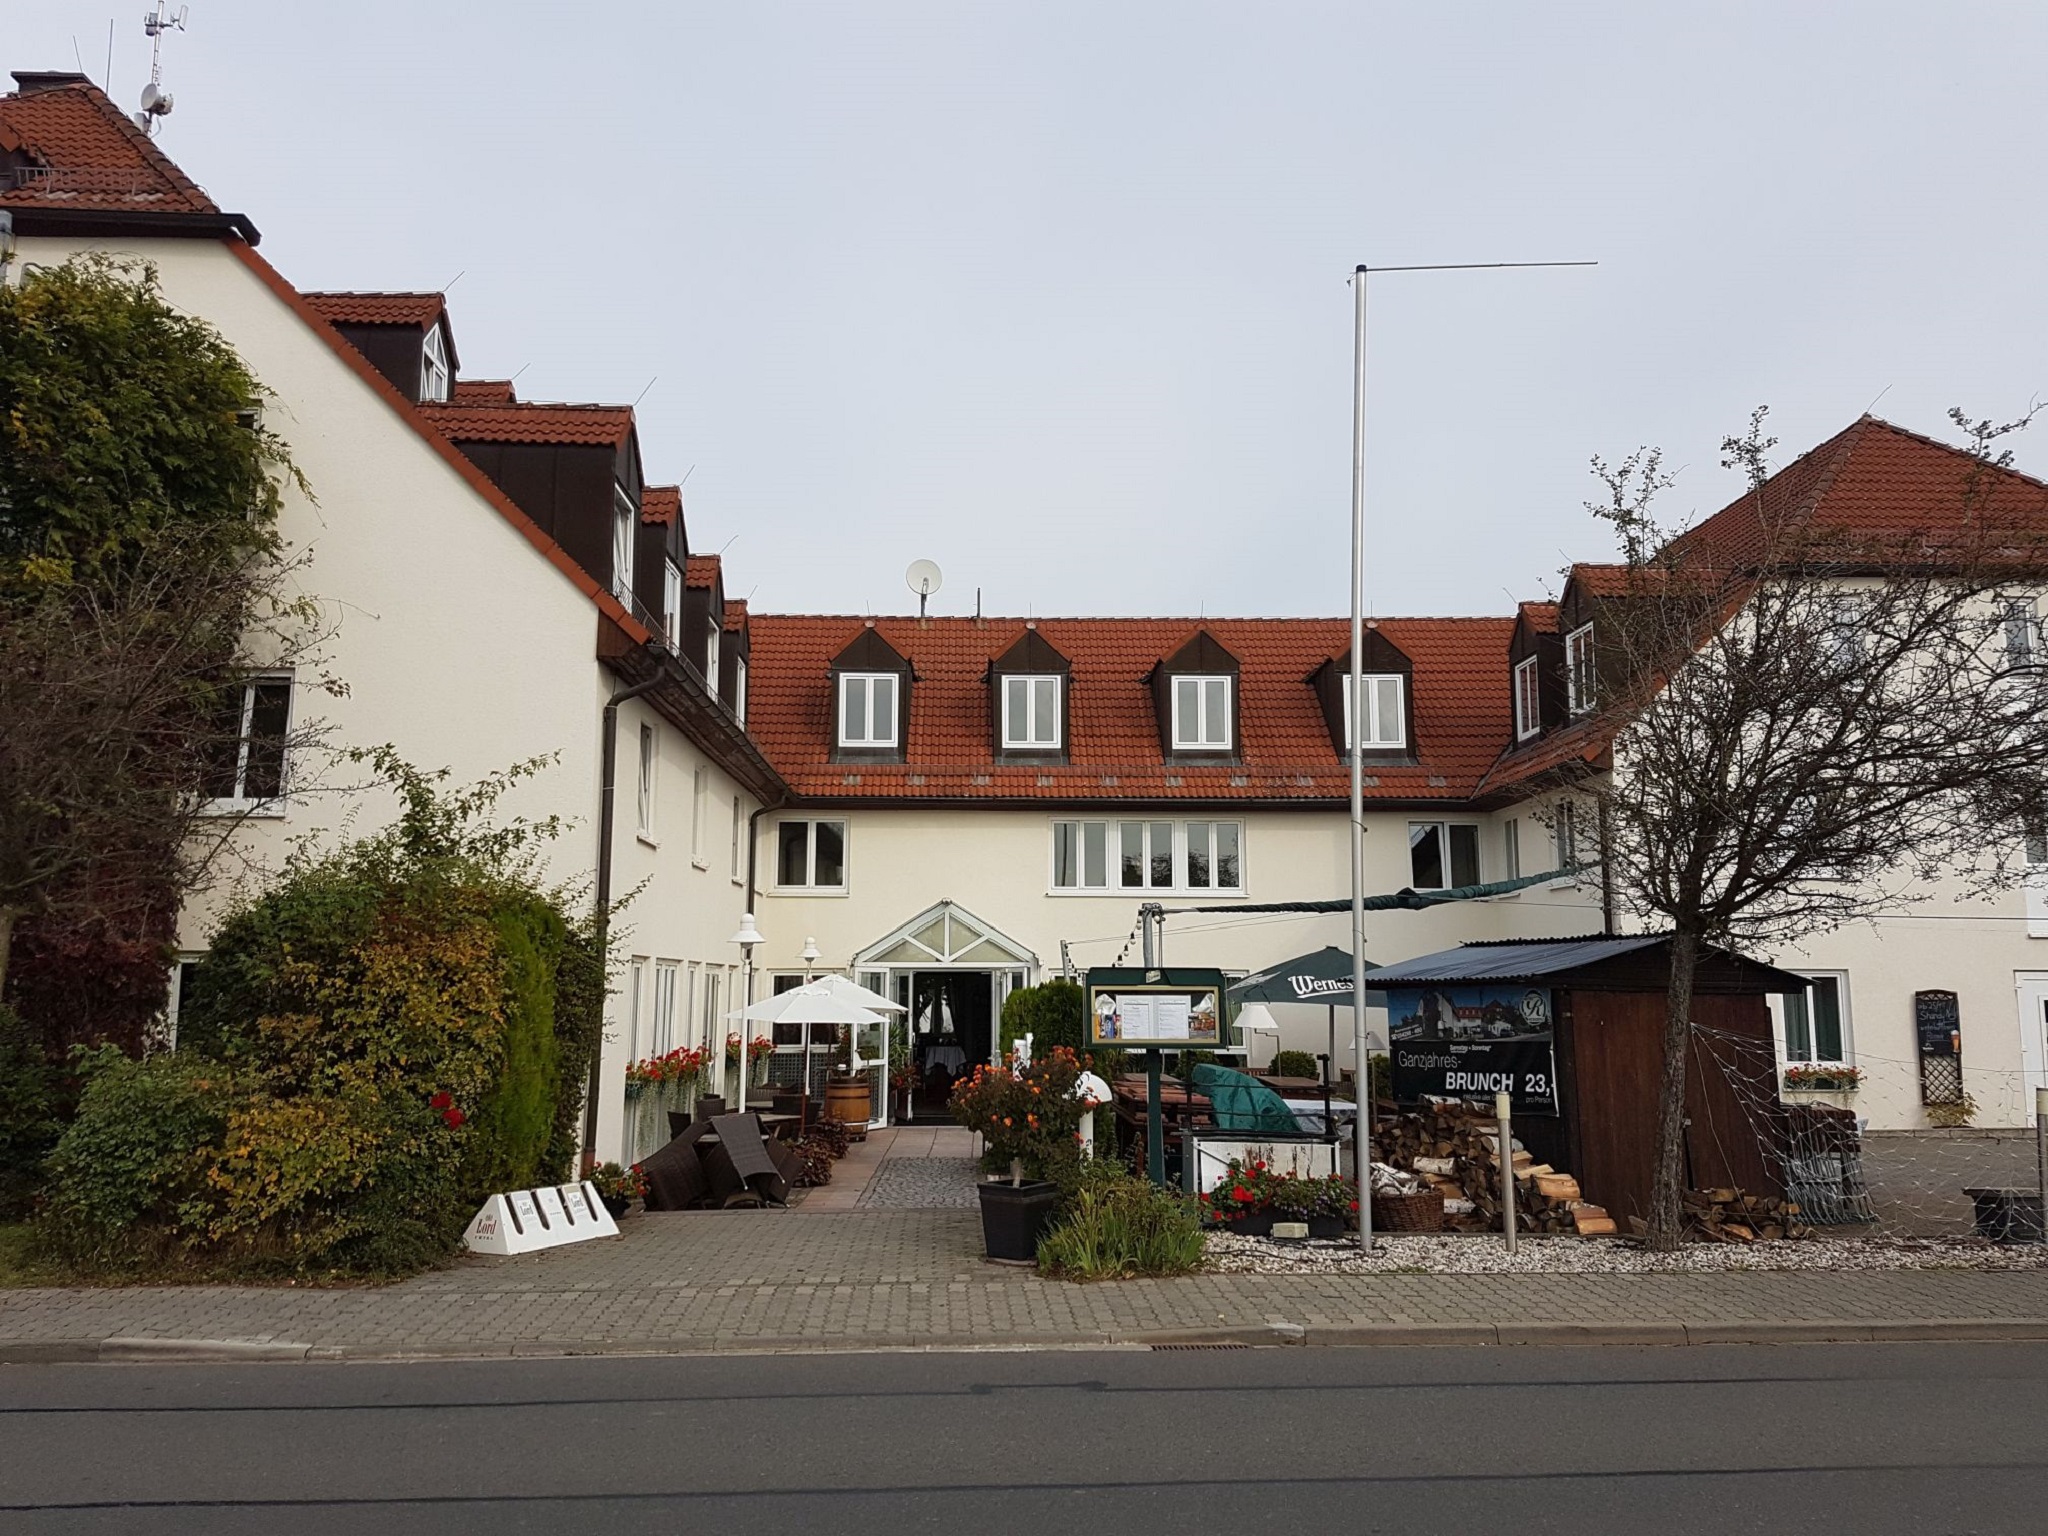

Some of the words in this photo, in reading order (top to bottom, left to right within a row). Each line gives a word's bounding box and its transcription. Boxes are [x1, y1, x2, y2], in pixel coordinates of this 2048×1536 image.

[1287, 975, 1354, 995] Wernes
[1398, 1050, 1462, 1071] Ganzjahres-
[1445, 1071, 1514, 1091] BRUNCH
[476, 1218, 497, 1235] Lord
